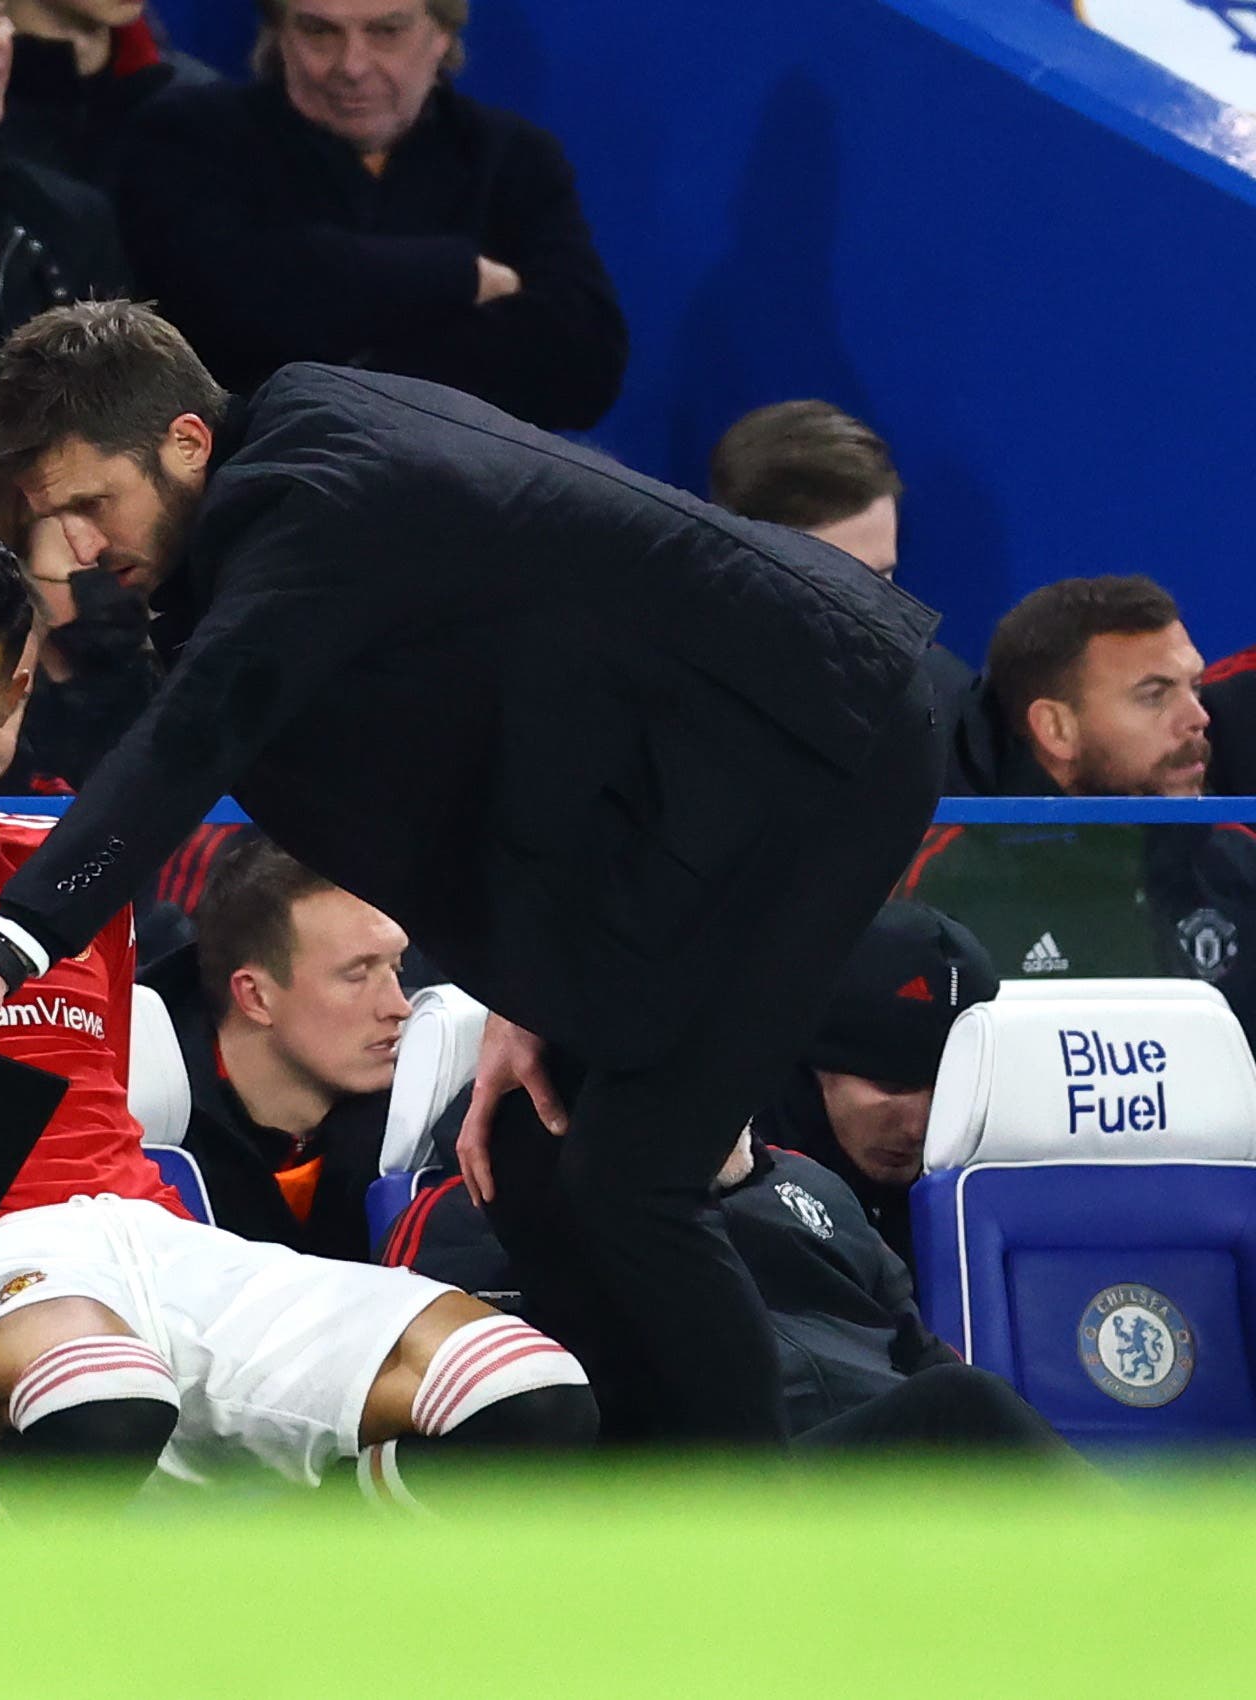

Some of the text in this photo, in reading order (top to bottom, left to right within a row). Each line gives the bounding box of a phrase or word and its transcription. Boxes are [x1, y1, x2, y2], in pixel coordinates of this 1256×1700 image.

[1059, 1030, 1166, 1076] Blue
[1067, 1081, 1166, 1134] Fuel
[1096, 1286, 1168, 1317] CHELSEA
